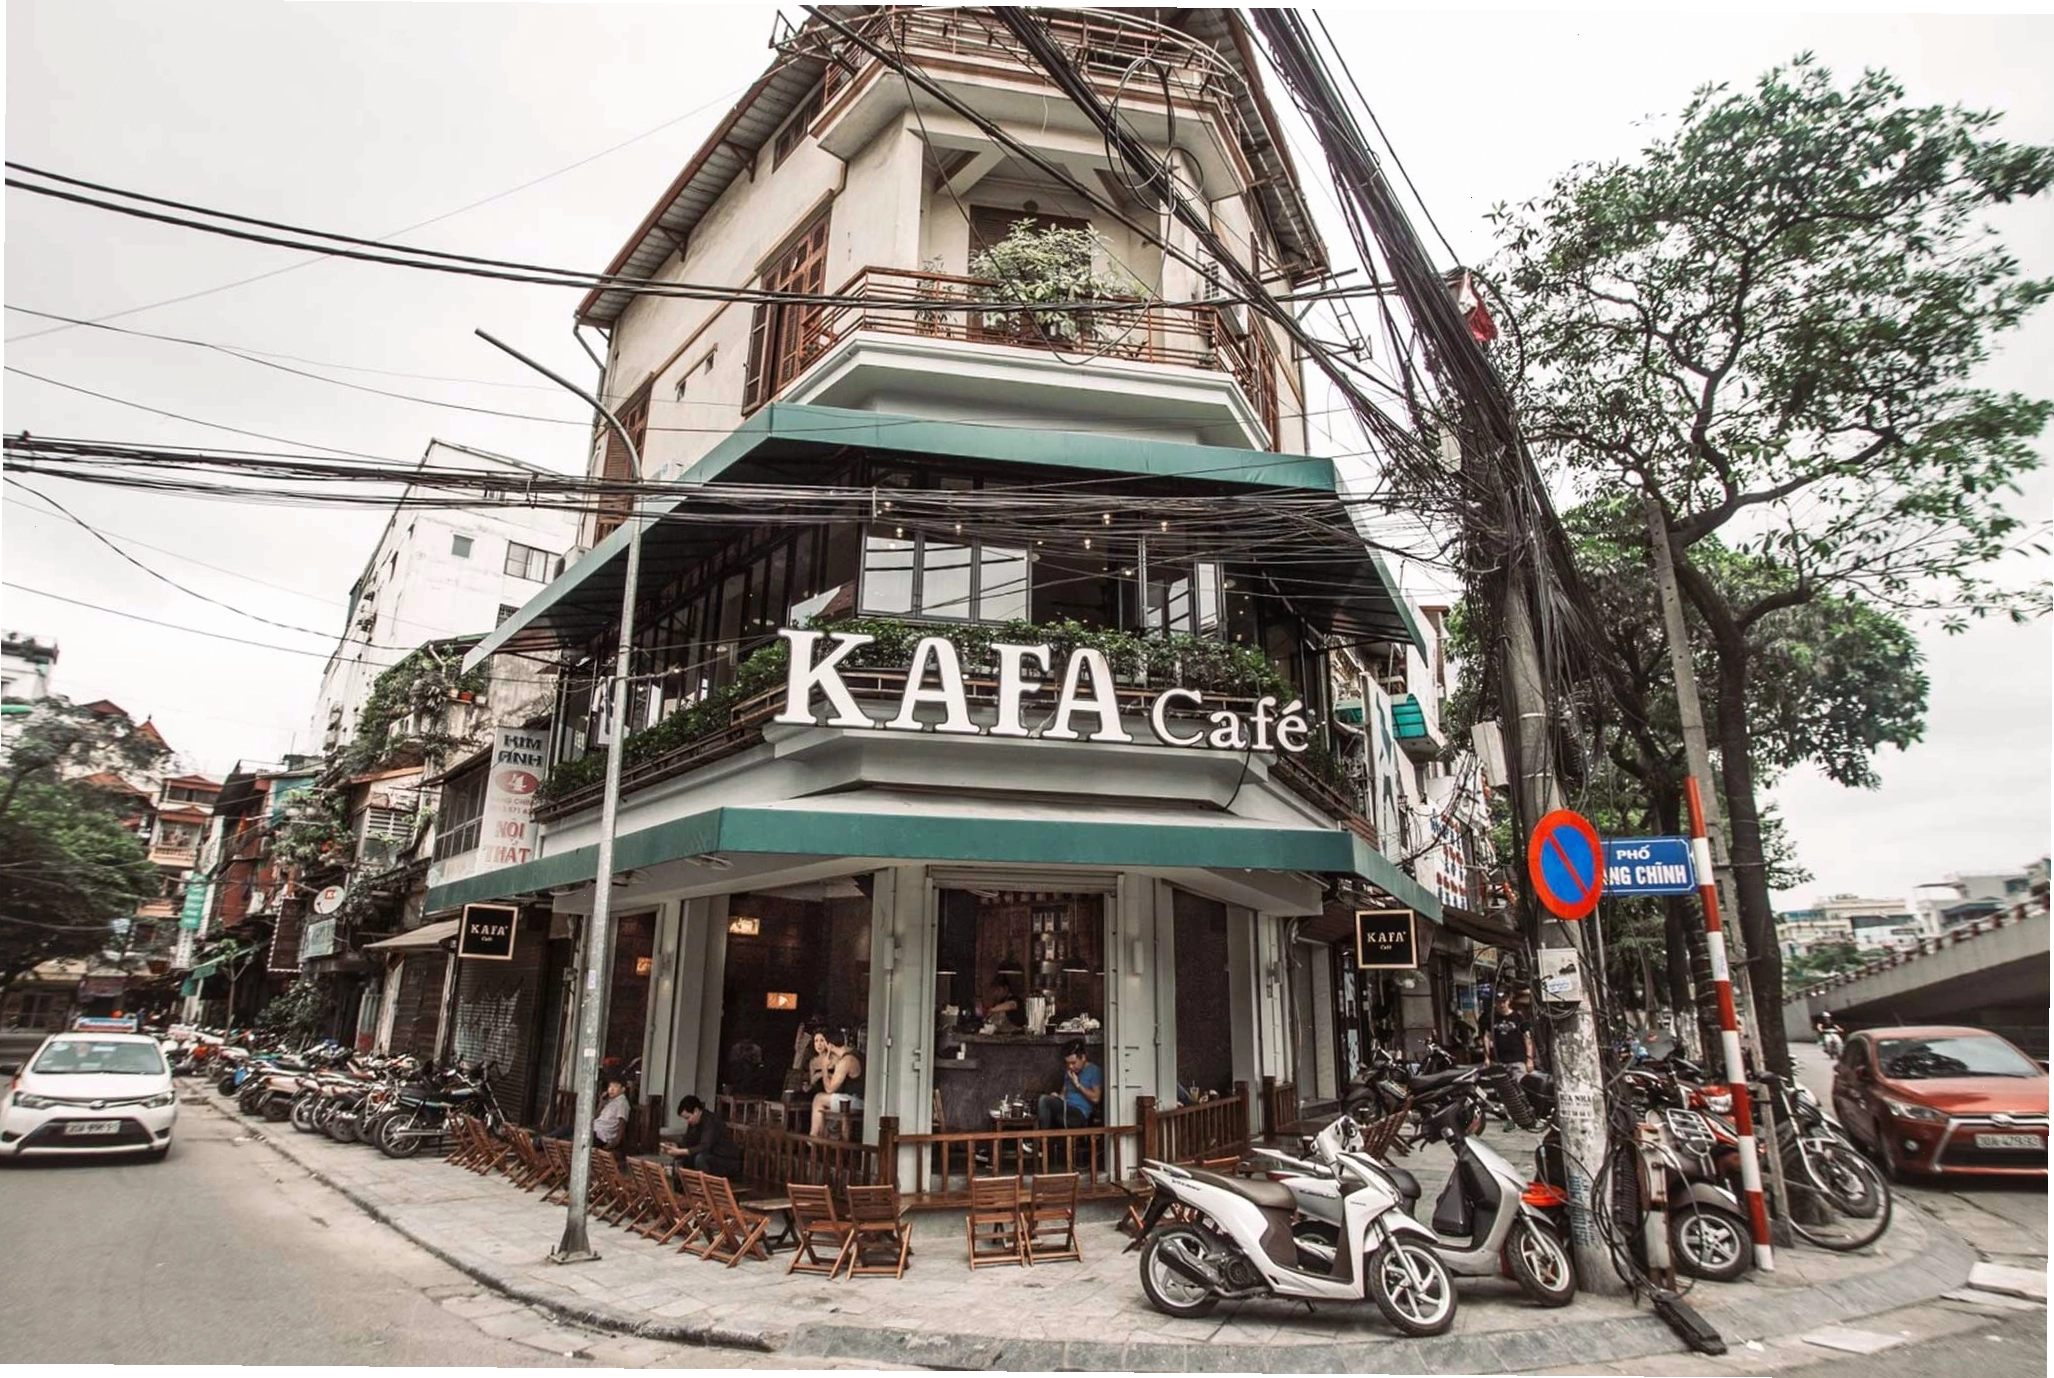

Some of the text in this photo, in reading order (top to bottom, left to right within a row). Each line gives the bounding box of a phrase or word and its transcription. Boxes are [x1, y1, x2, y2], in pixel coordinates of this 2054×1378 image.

[774, 628, 1309, 752] KAFA Café
[503, 734, 542, 750] KIM
[508, 773, 527, 791] 4
[1616, 844, 1650, 860] PHỐ
[470, 924, 507, 936] KAFA
[1367, 932, 1405, 942] KAFA
